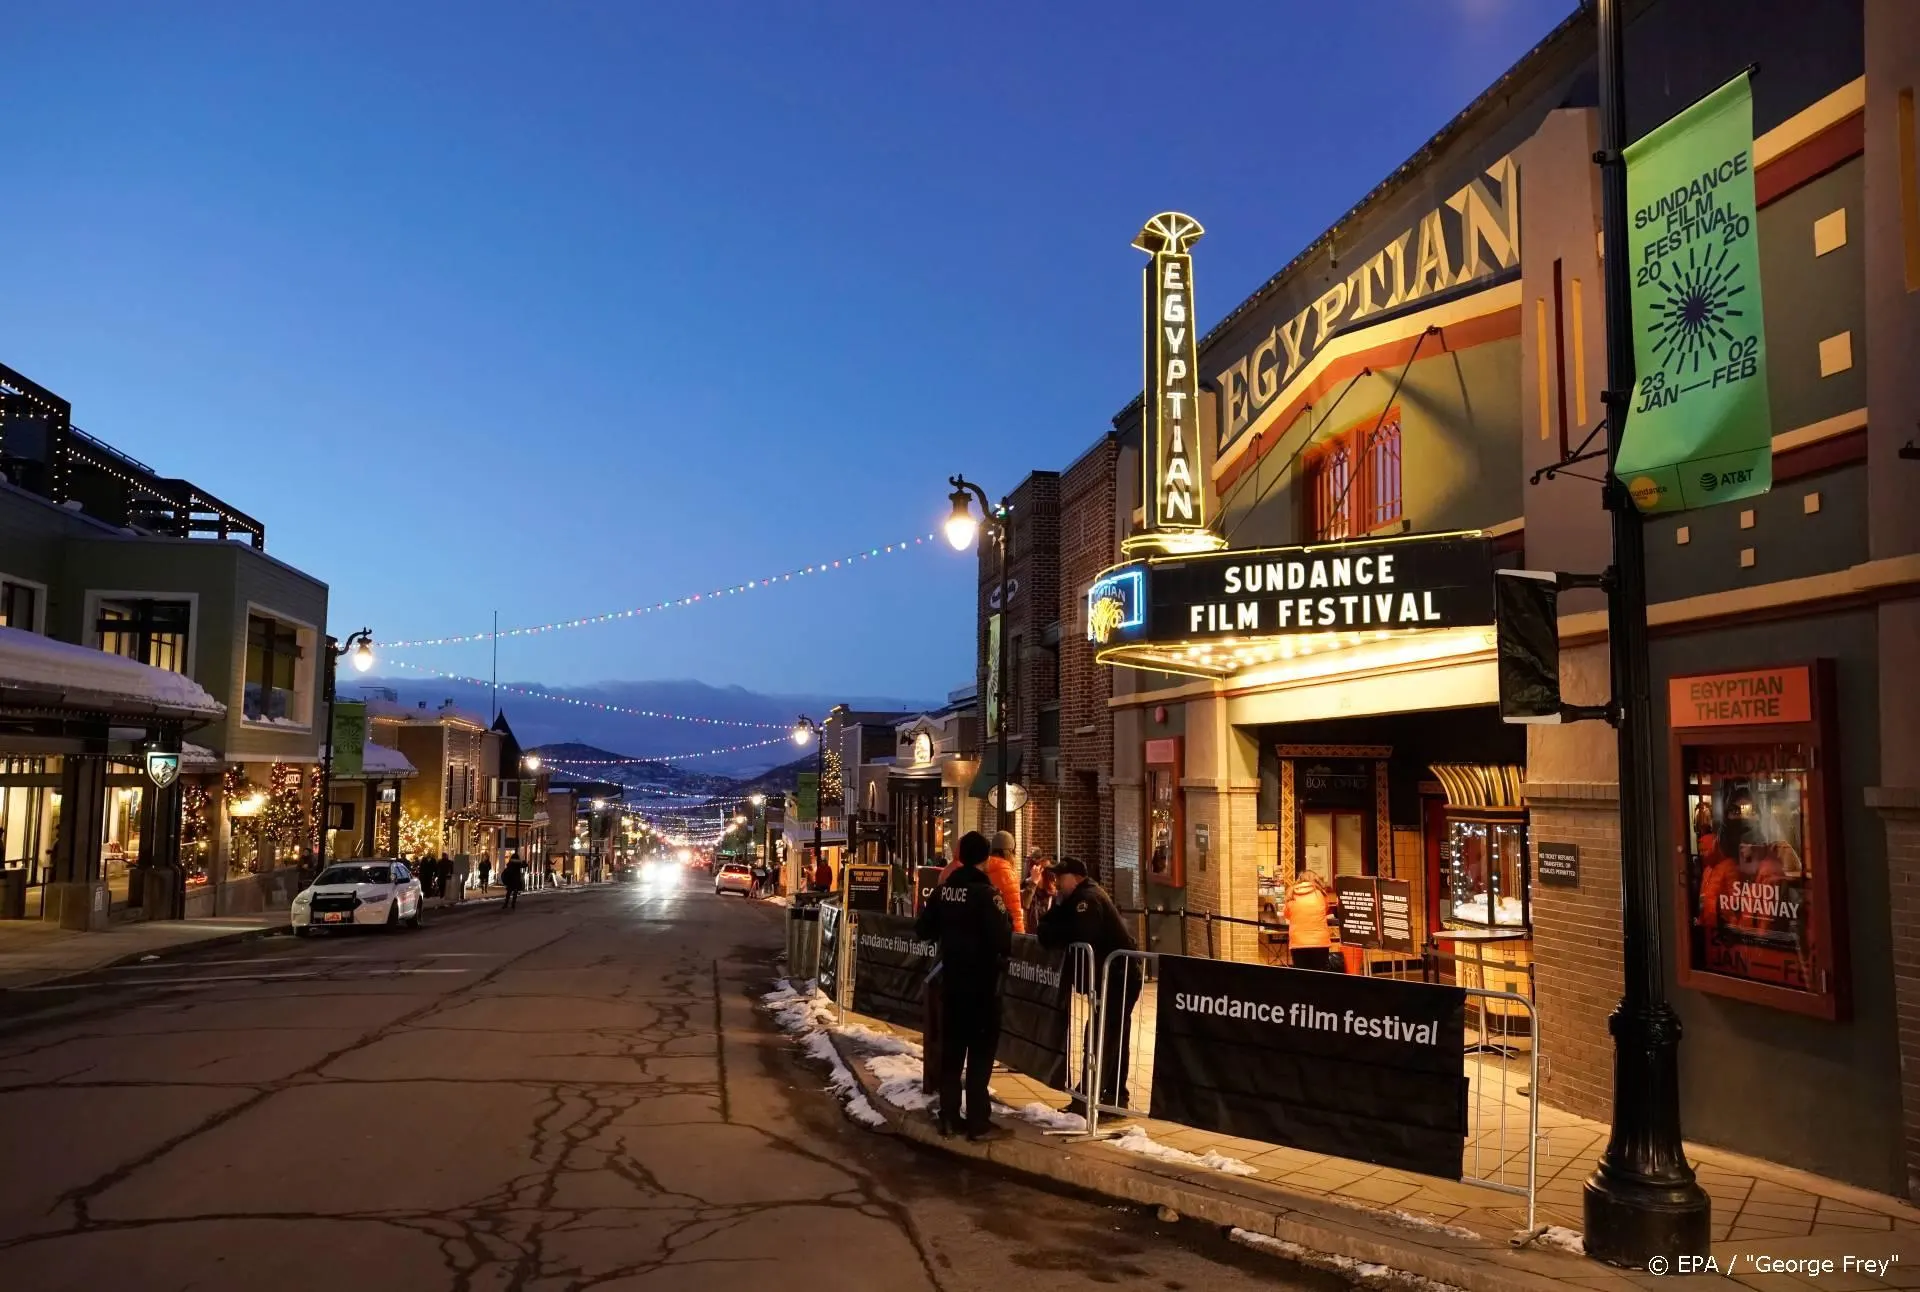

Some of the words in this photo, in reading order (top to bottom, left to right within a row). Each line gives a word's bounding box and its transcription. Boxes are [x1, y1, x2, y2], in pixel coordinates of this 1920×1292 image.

[1634, 150, 1748, 230] SUNDANCE
[1666, 191, 1714, 234] FILM
[1644, 202, 1739, 264] FESTIVAL
[1722, 215, 1750, 246] 20
[1636, 260, 1662, 288] 20
[1216, 155, 1520, 451] EGYPTIAN
[1728, 335, 1758, 362] 02
[1162, 262, 1193, 519] EGYPTIAN
[1640, 371, 1665, 396] 23
[1720, 468, 1755, 486] AT&T
[1224, 554, 1395, 594] SUNDANCE
[1190, 601, 1259, 633] FILM
[1278, 591, 1441, 628] FESTIVAL
[1690, 676, 1784, 700] EGYPTIAN
[1695, 698, 1780, 721] THEATRE
[1306, 776, 1327, 789] BOX
[941, 886, 968, 902] POLICE
[1732, 881, 1780, 901] SAUDI
[1720, 894, 1800, 919] RUNAWAY
[860, 933, 893, 950] sundance
[893, 936, 909, 953] film
[909, 939, 937, 957] festival
[1021, 961, 1035, 982] film
[1175, 991, 1285, 1024] sundance
[1289, 1003, 1338, 1032] film
[1343, 1009, 1439, 1046] festival
